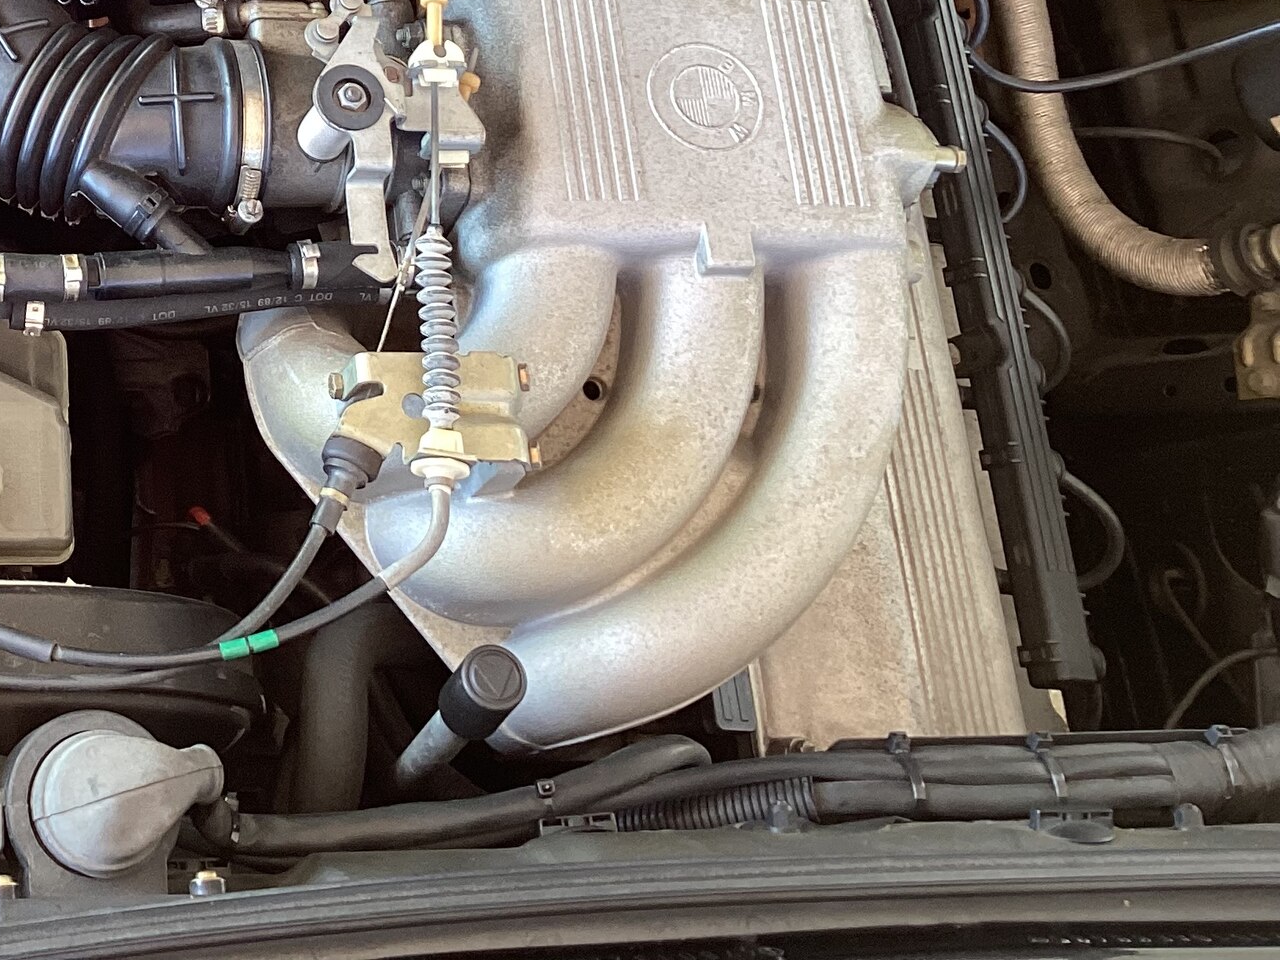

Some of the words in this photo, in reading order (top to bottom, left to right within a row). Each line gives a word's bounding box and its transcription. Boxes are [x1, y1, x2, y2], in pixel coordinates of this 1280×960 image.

[258, 294, 287, 308] 12/89
[294, 293, 303, 302] C
[308, 290, 333, 303] DOT
[203, 303, 219, 314] VL
[222, 299, 251, 312] 15/32
[151, 309, 176, 321] DOT
